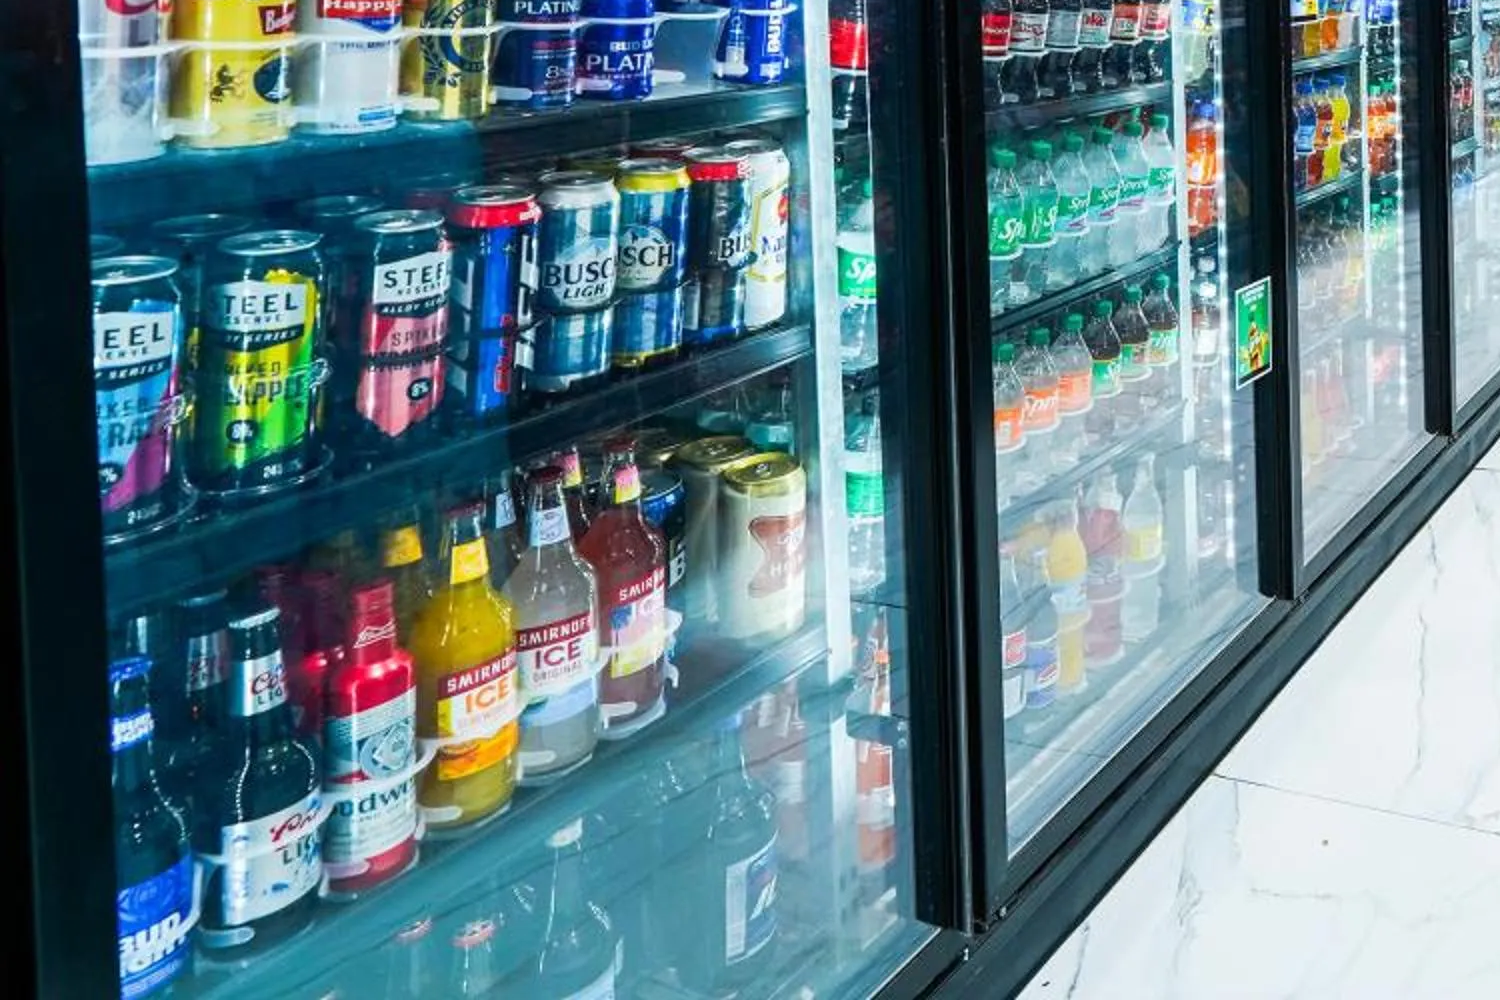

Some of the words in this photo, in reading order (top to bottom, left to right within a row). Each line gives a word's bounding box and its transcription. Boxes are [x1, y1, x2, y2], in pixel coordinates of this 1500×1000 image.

[614, 243, 673, 268] USCH
[543, 257, 614, 288] BUSC
[223, 289, 299, 317] TEEL
[103, 320, 167, 350] EEL
[534, 642, 582, 669] ICE
[446, 653, 517, 694] SMIRNO
[463, 677, 514, 715] ICE
